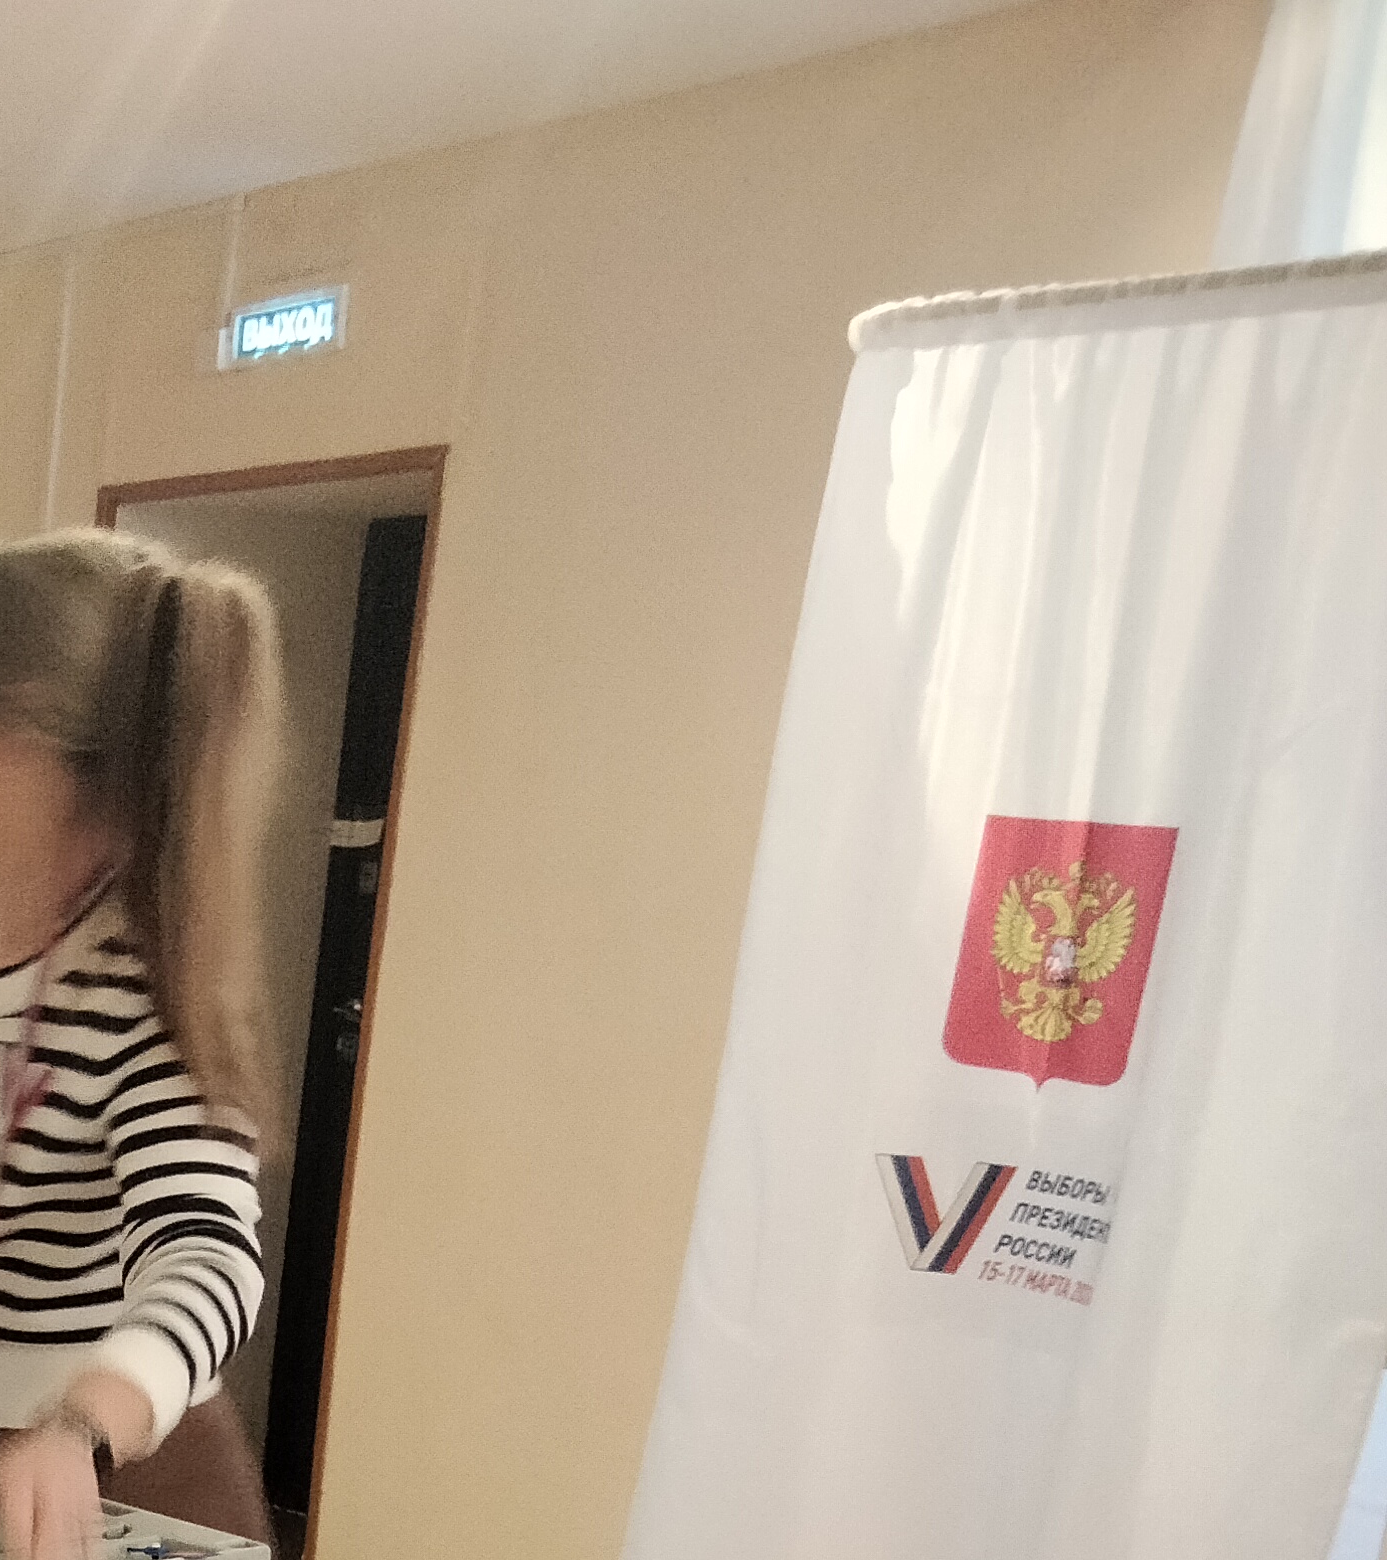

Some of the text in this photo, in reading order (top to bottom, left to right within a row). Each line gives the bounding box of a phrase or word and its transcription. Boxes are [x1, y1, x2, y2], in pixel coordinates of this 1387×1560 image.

[242, 302, 334, 352] ВЫХОД
[1025, 1169, 1110, 1204] ВЫБОРЫ
[993, 1234, 1078, 1268] РОССИИ
[977, 1260, 1025, 1285] 15-17
